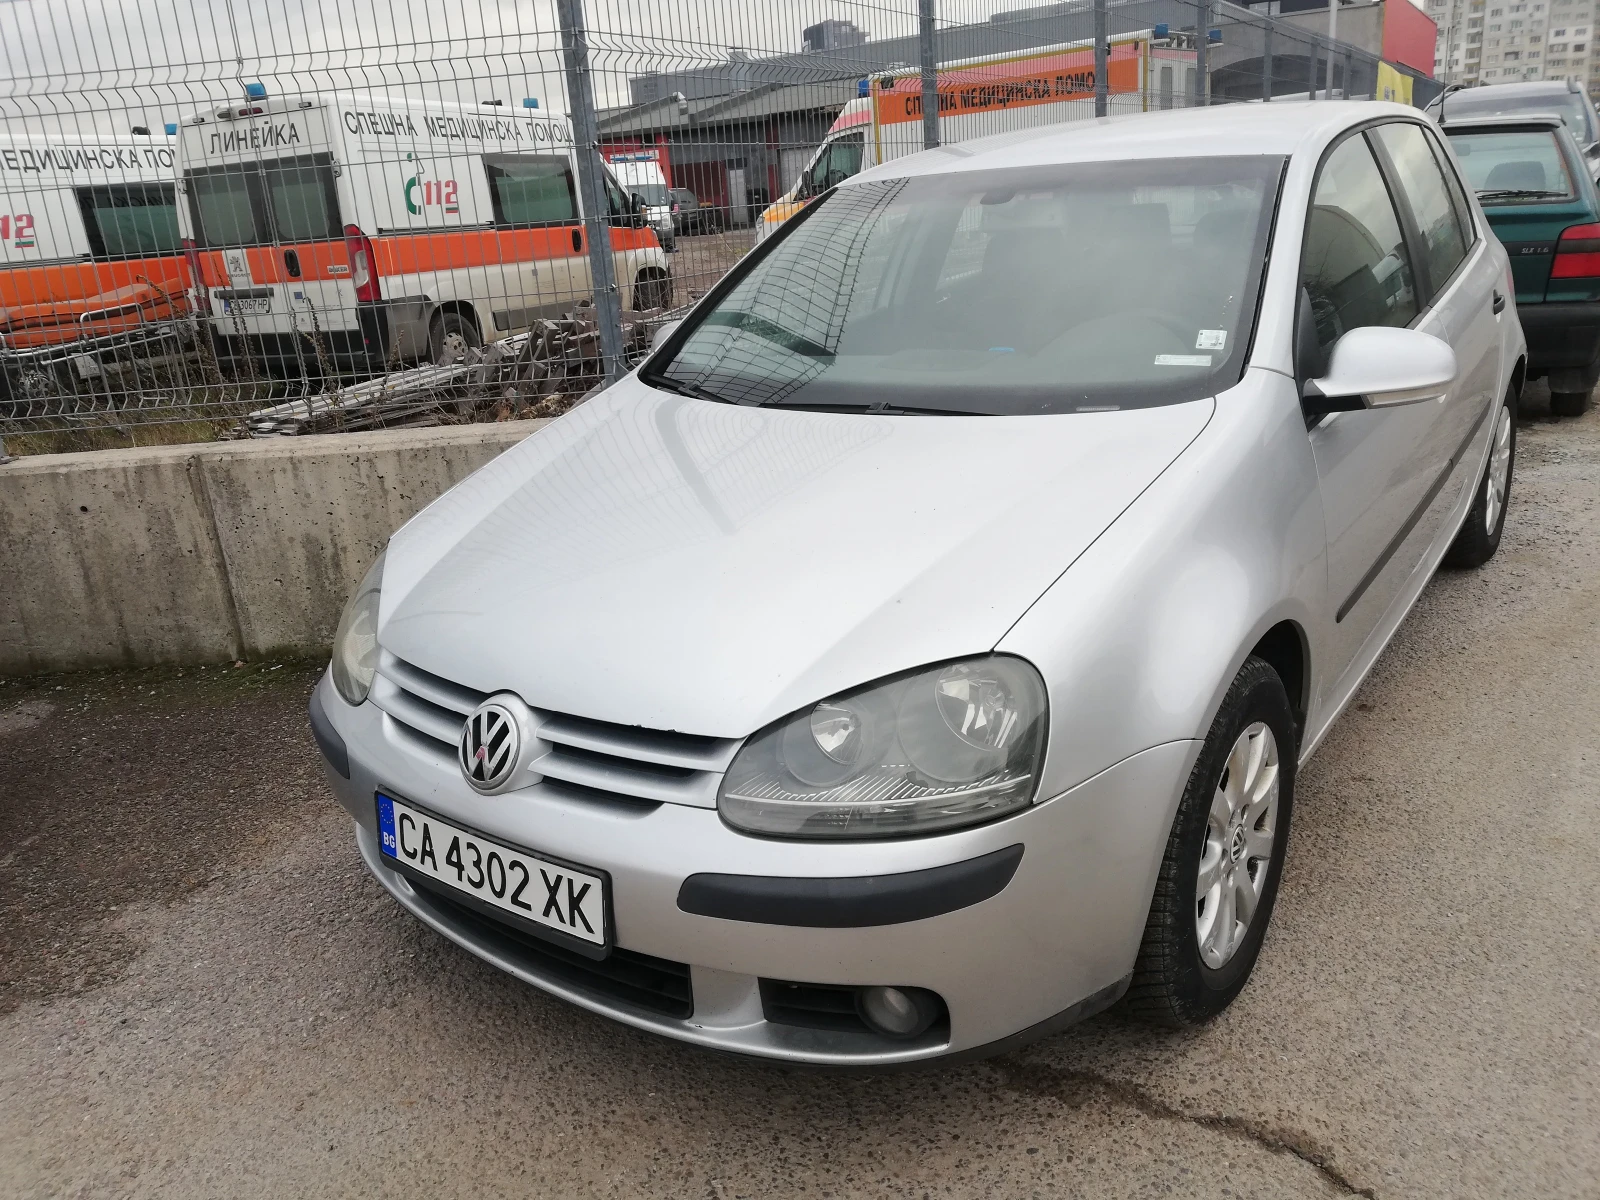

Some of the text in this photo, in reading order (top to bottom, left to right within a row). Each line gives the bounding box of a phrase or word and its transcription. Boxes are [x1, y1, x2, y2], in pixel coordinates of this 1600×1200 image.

[1055, 69, 1108, 96] ПОМО
[211, 120, 300, 154] ЛИНЕЙКА
[344, 111, 418, 137] СПЕШНА
[424, 115, 523, 142] МЕДИЦИНСКА
[0, 149, 143, 173] ЕДИЦИНСКА
[424, 180, 458, 205] 112
[383, 831, 396, 849] BG
[399, 812, 595, 935] CA 4302 XK
